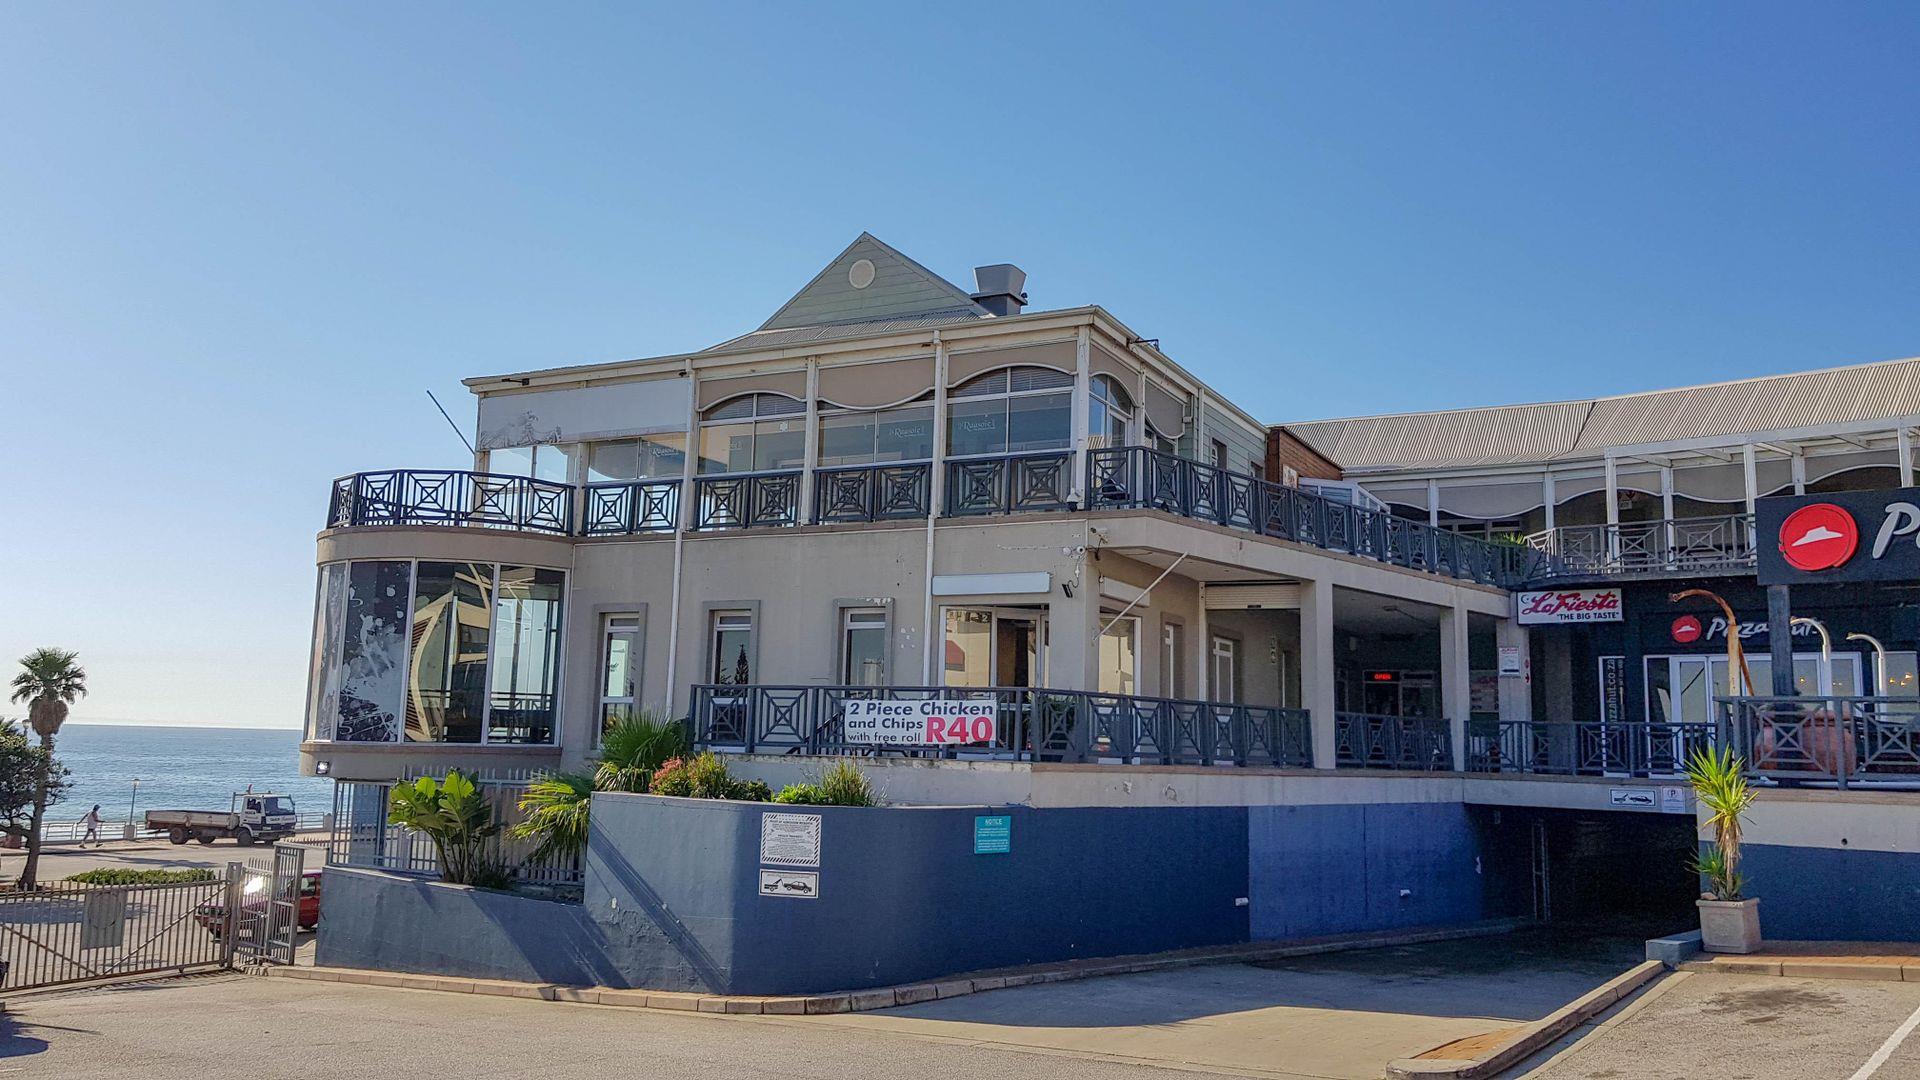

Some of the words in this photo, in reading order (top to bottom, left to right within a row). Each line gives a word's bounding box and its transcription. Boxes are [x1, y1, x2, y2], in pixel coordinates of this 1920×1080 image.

[1872, 502, 1920, 559] P
[1576, 612, 1591, 620] BIG
[850, 702, 860, 715] 2
[866, 702, 913, 715] Piece
[920, 701, 993, 715] Chicken
[848, 718, 876, 729] and
[881, 717, 923, 731] Chips
[926, 716, 993, 743] R40
[848, 732, 870, 742] with
[874, 732, 897, 742] free
[901, 732, 921, 742] roll
